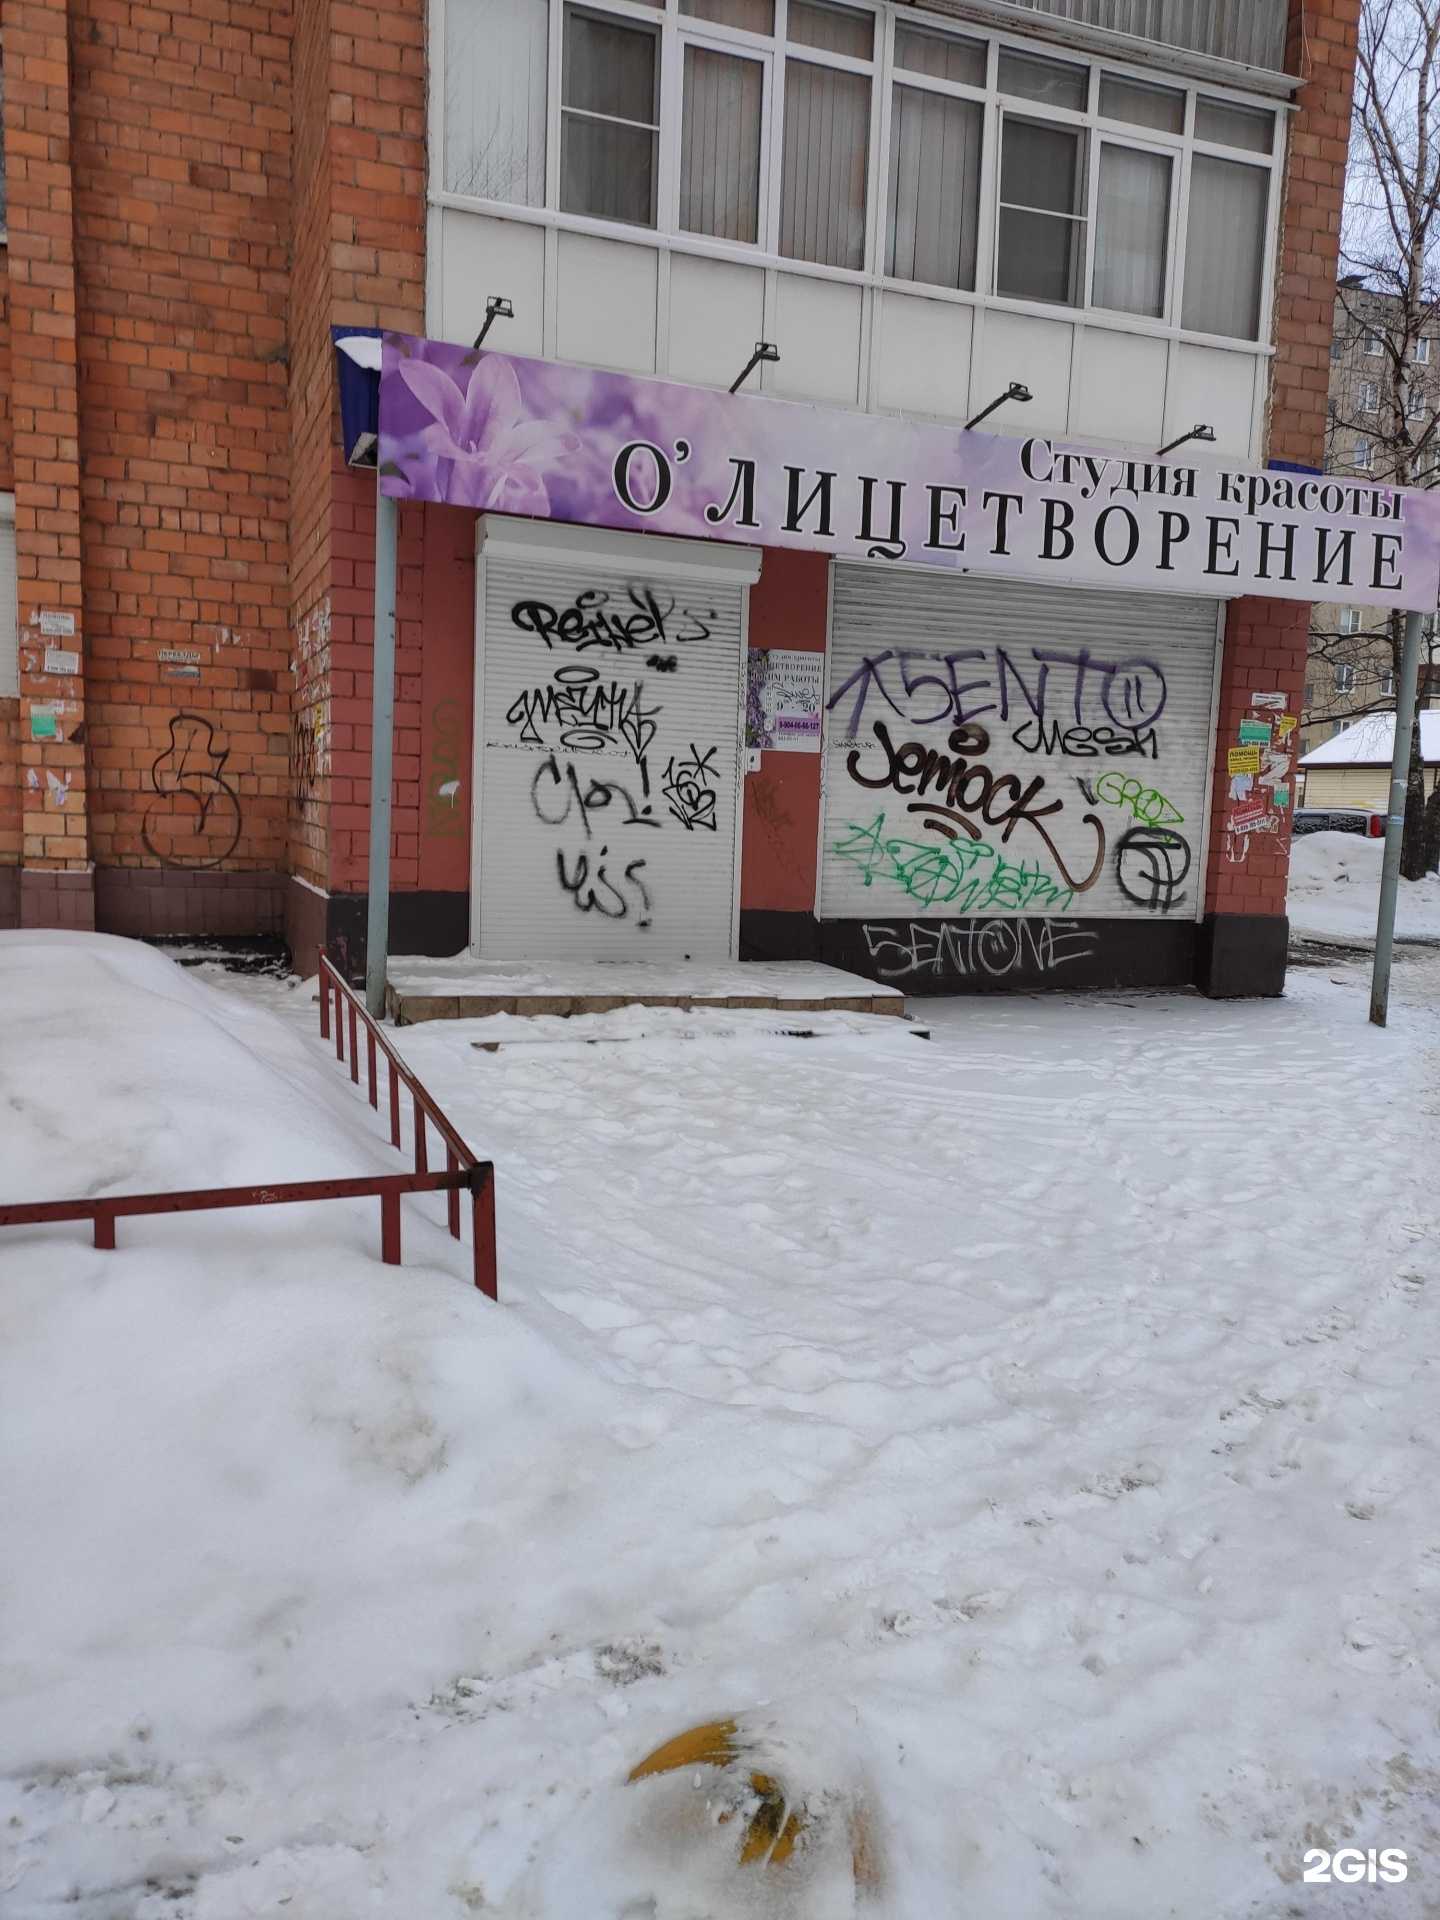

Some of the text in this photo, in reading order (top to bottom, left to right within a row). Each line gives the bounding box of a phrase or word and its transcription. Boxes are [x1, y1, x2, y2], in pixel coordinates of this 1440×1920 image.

[1020, 437, 1404, 521] Студия красоты
[801, 702, 816, 713] 20
